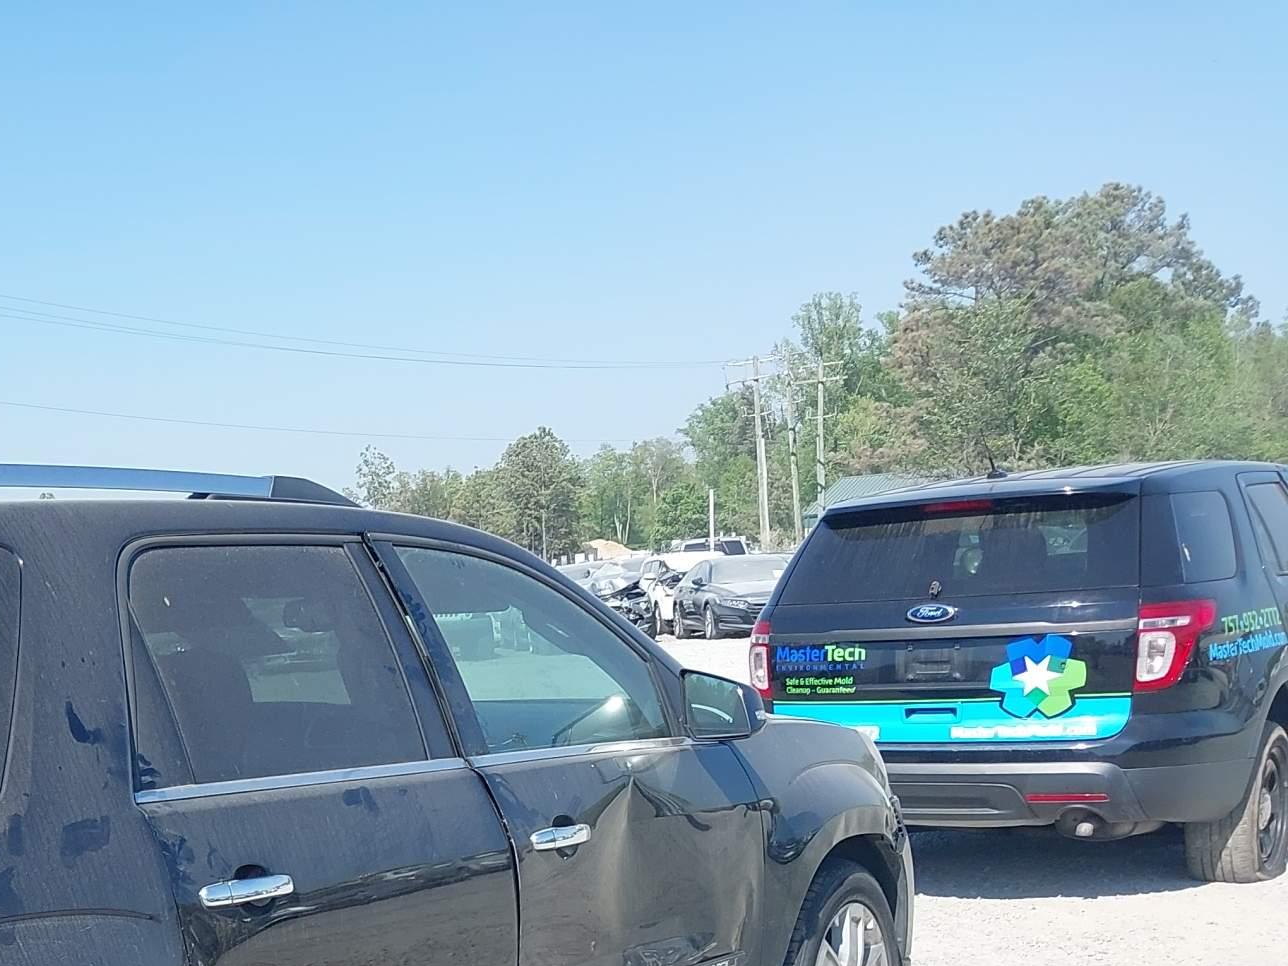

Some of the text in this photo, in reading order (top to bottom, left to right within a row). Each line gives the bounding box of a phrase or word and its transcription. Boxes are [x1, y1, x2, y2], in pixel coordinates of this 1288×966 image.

[916, 606, 944, 618] Ford
[776, 644, 866, 662] MasterTech
[776, 663, 865, 672] ENVIRONMENTAL
[785, 676, 854, 686] Safe & Effective Mold
[786, 686, 811, 695] Cleanup
[816, 686, 856, 695] Guaranteed
